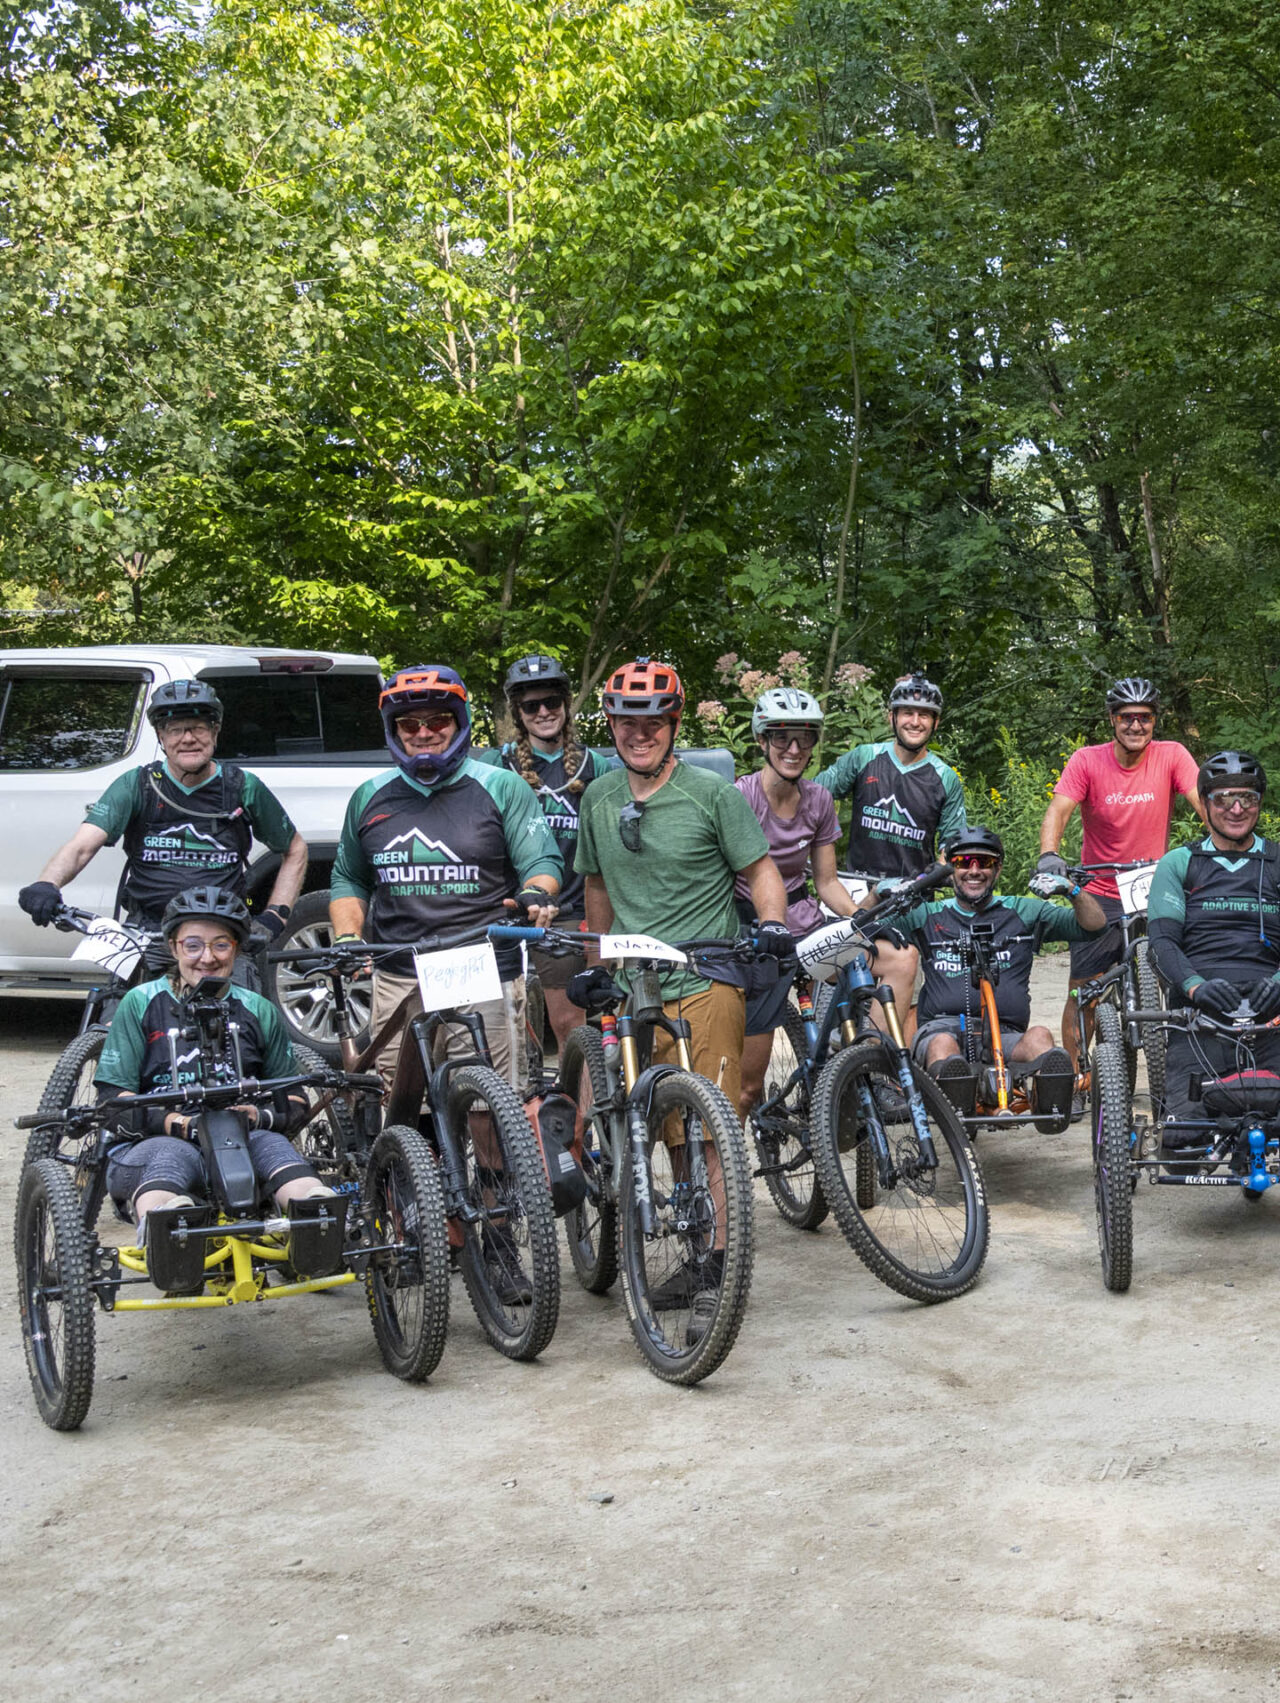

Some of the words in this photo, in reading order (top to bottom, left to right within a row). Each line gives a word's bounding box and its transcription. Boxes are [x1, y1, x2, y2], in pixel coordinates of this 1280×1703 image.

[863, 805, 889, 818] GREEN
[861, 816, 926, 840] MOUNTAIN
[144, 836, 181, 848] GREEN
[142, 849, 238, 863] MOUNTAIN
[373, 851, 408, 864] GREEN
[376, 865, 480, 883] MOUNTAIN
[390, 884, 437, 897] ADAPTIVE
[440, 883, 480, 895] SPORTS
[1202, 901, 1248, 912] ADAPTIVE
[632, 1161, 650, 1206] FOX
[964, 1147, 985, 1206] MAXXIS
